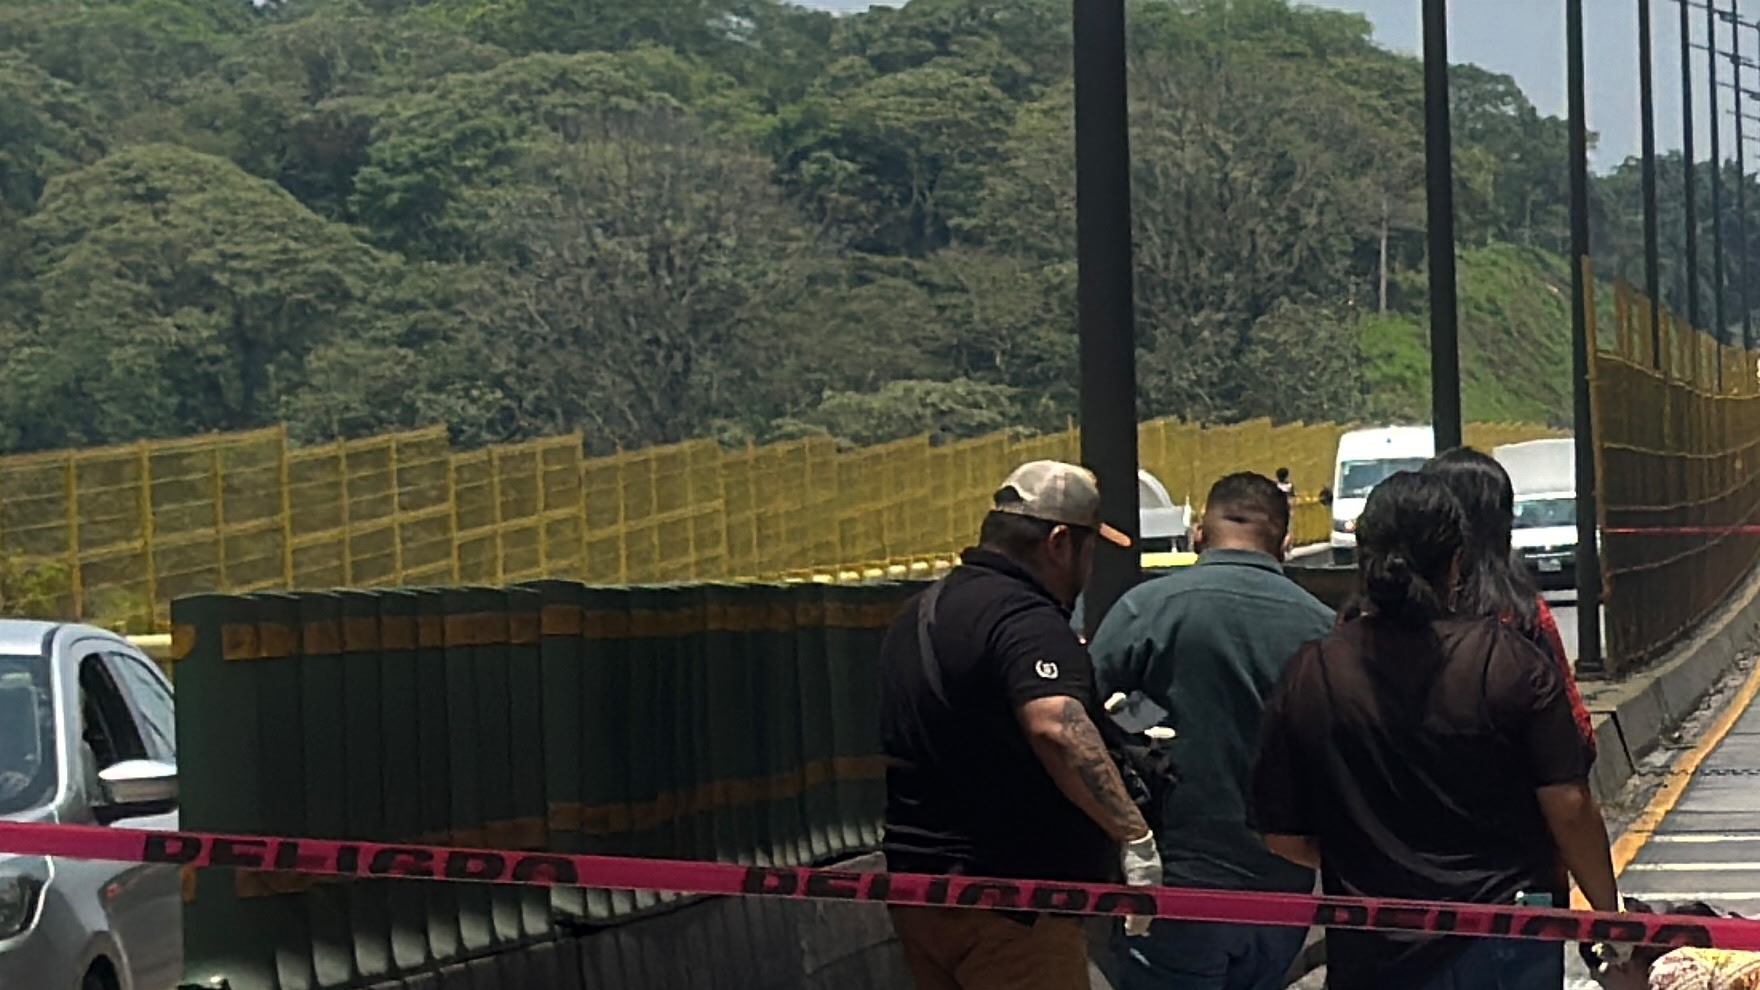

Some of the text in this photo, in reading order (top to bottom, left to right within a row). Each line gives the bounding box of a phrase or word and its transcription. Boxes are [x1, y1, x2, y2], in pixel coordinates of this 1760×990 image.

[142, 832, 579, 885] PELIGRO
[742, 866, 1158, 916] PELIGRO
[1312, 902, 1713, 948] PELIGRO
